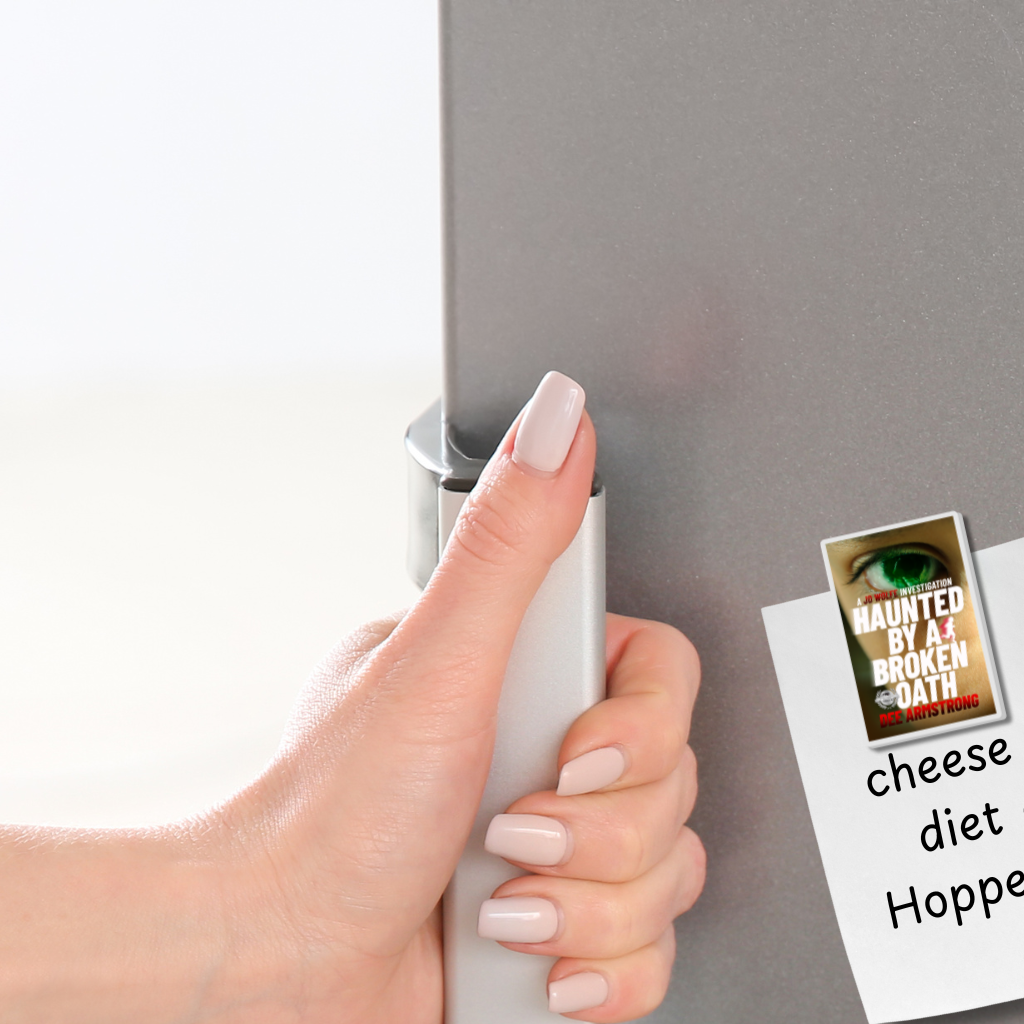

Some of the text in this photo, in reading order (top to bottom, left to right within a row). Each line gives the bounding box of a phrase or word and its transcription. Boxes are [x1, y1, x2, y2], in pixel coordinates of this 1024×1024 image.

[853, 585, 965, 636] HAUNTED
[856, 577, 953, 607] A JO WOLFE INVESTIGATION
[888, 619, 942, 655] BY A
[873, 640, 969, 687] BROKEN
[879, 710, 903, 728] DEE
[906, 693, 980, 723] ARMSTRONG
[895, 671, 958, 709] OATH
[867, 738, 1012, 797] cheese
[920, 802, 1004, 852] diet
